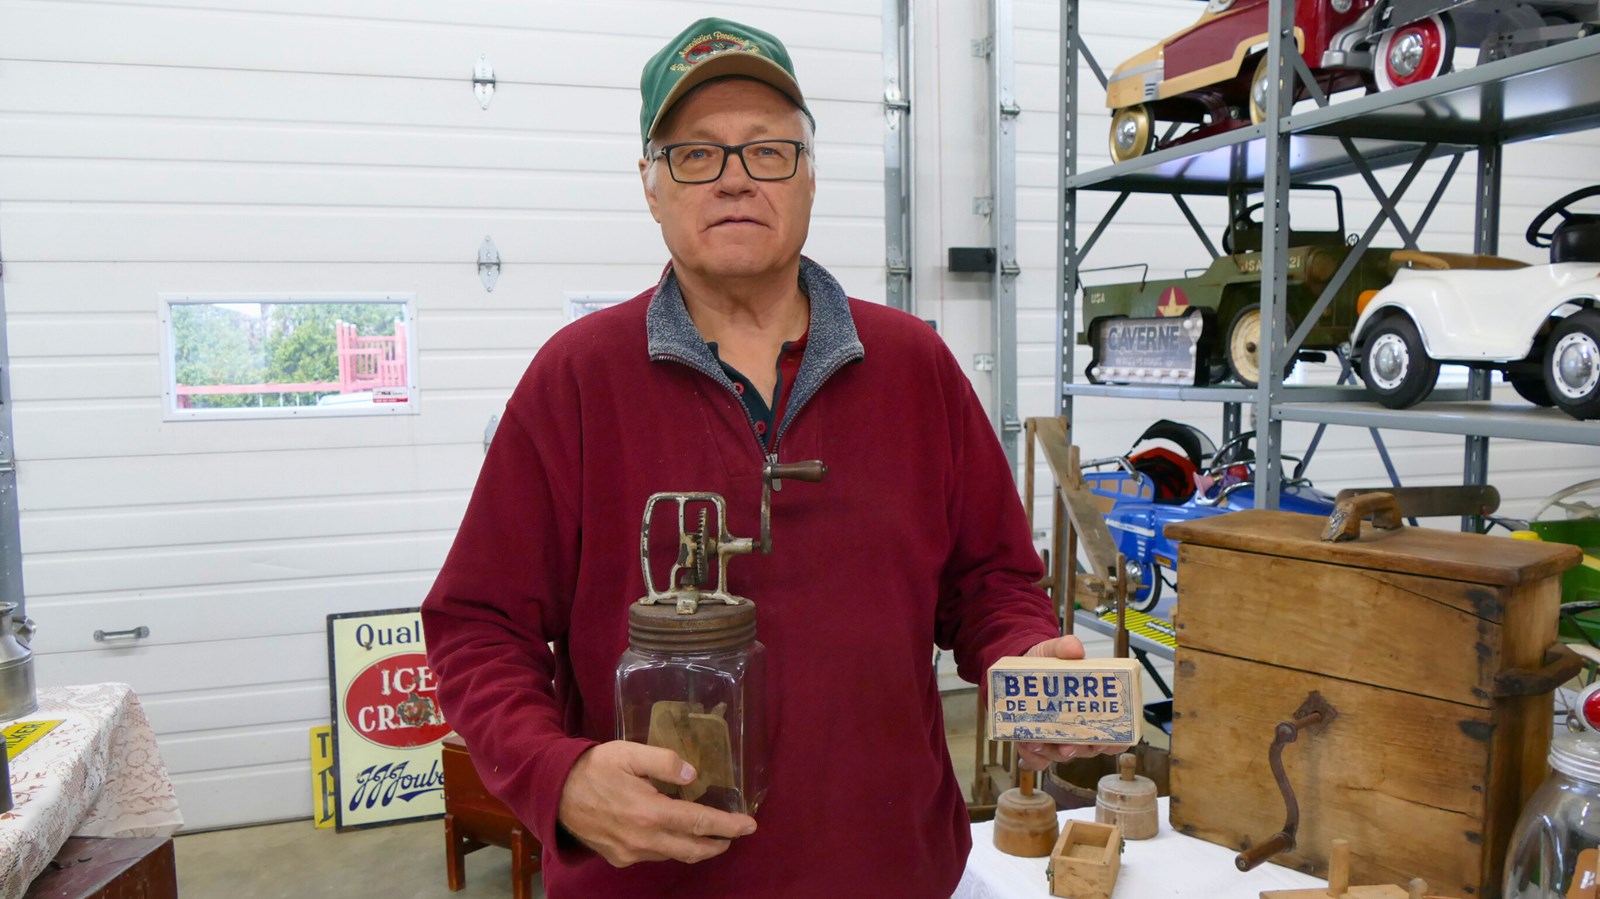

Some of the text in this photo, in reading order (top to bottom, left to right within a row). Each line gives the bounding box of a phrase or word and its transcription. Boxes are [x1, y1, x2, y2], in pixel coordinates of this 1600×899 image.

[1090, 292, 1106, 304] USA
[1108, 325, 1181, 352] CAVERNE
[356, 620, 421, 651] Qual
[381, 666, 438, 696] ICE
[1004, 675, 1119, 698] BEURRE
[1006, 700, 1120, 713] DE LAITERIE
